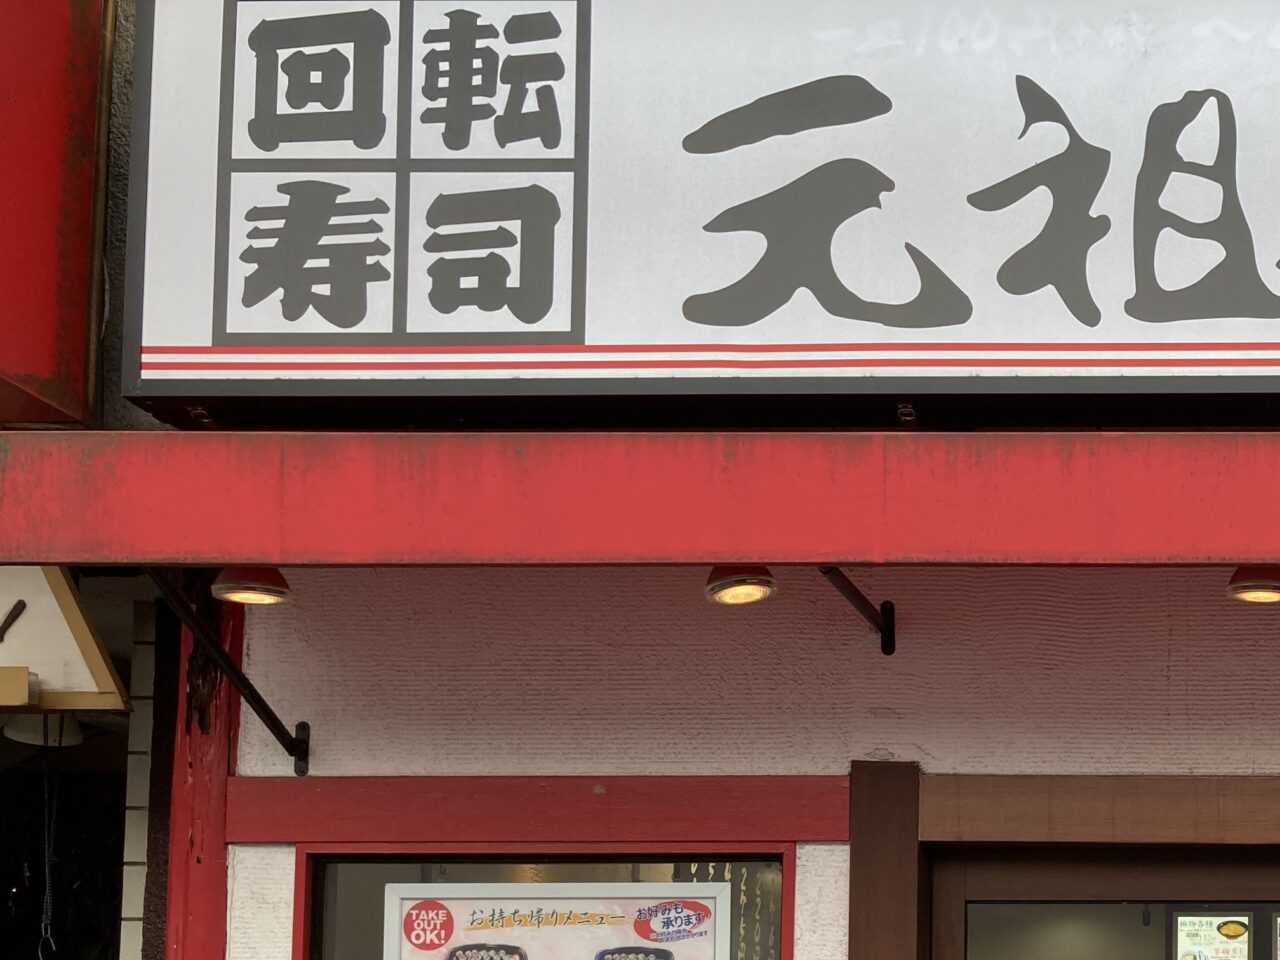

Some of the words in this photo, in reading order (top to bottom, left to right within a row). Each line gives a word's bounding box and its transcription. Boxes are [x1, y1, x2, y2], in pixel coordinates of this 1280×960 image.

[247, 8, 566, 152] 回転
[240, 179, 562, 329] 寿司
[410, 910, 447, 920] TAKE
[469, 908, 626, 928] お持ち帰りメニュー
[661, 912, 704, 930] 承ります
[413, 920, 443, 930] OUT
[410, 930, 446, 944] OK!
